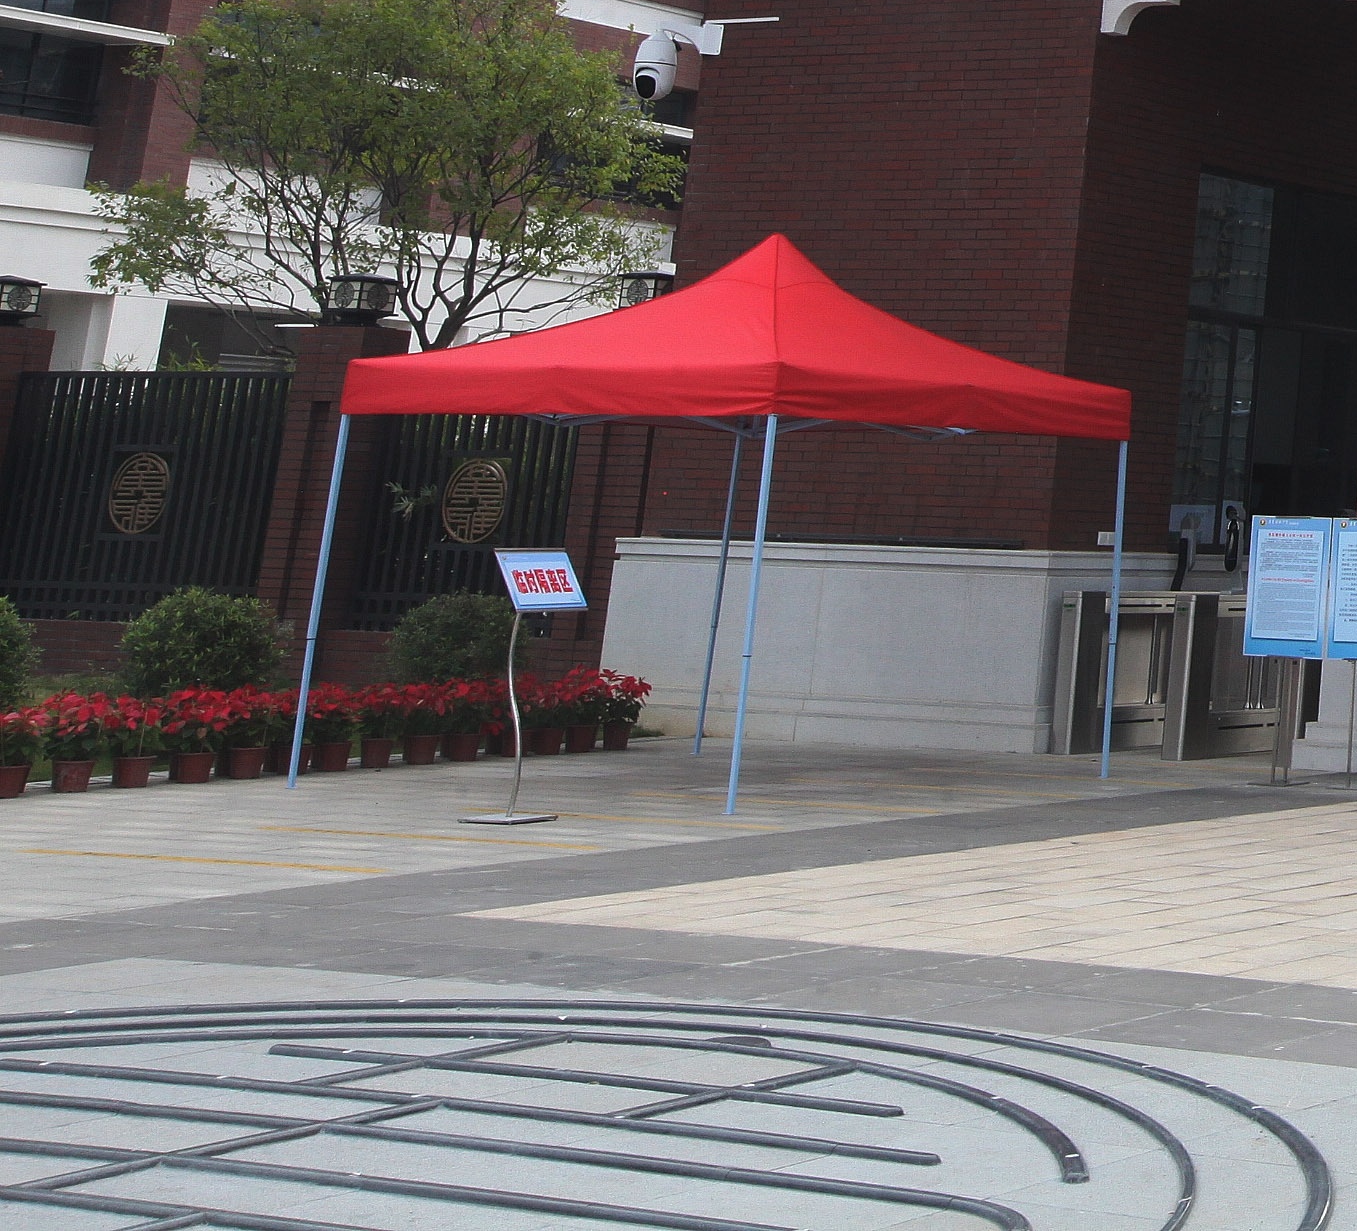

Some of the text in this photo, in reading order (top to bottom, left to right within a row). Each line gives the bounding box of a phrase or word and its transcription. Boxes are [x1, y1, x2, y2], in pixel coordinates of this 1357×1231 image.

[511, 569, 574, 594] 临时隔离区
